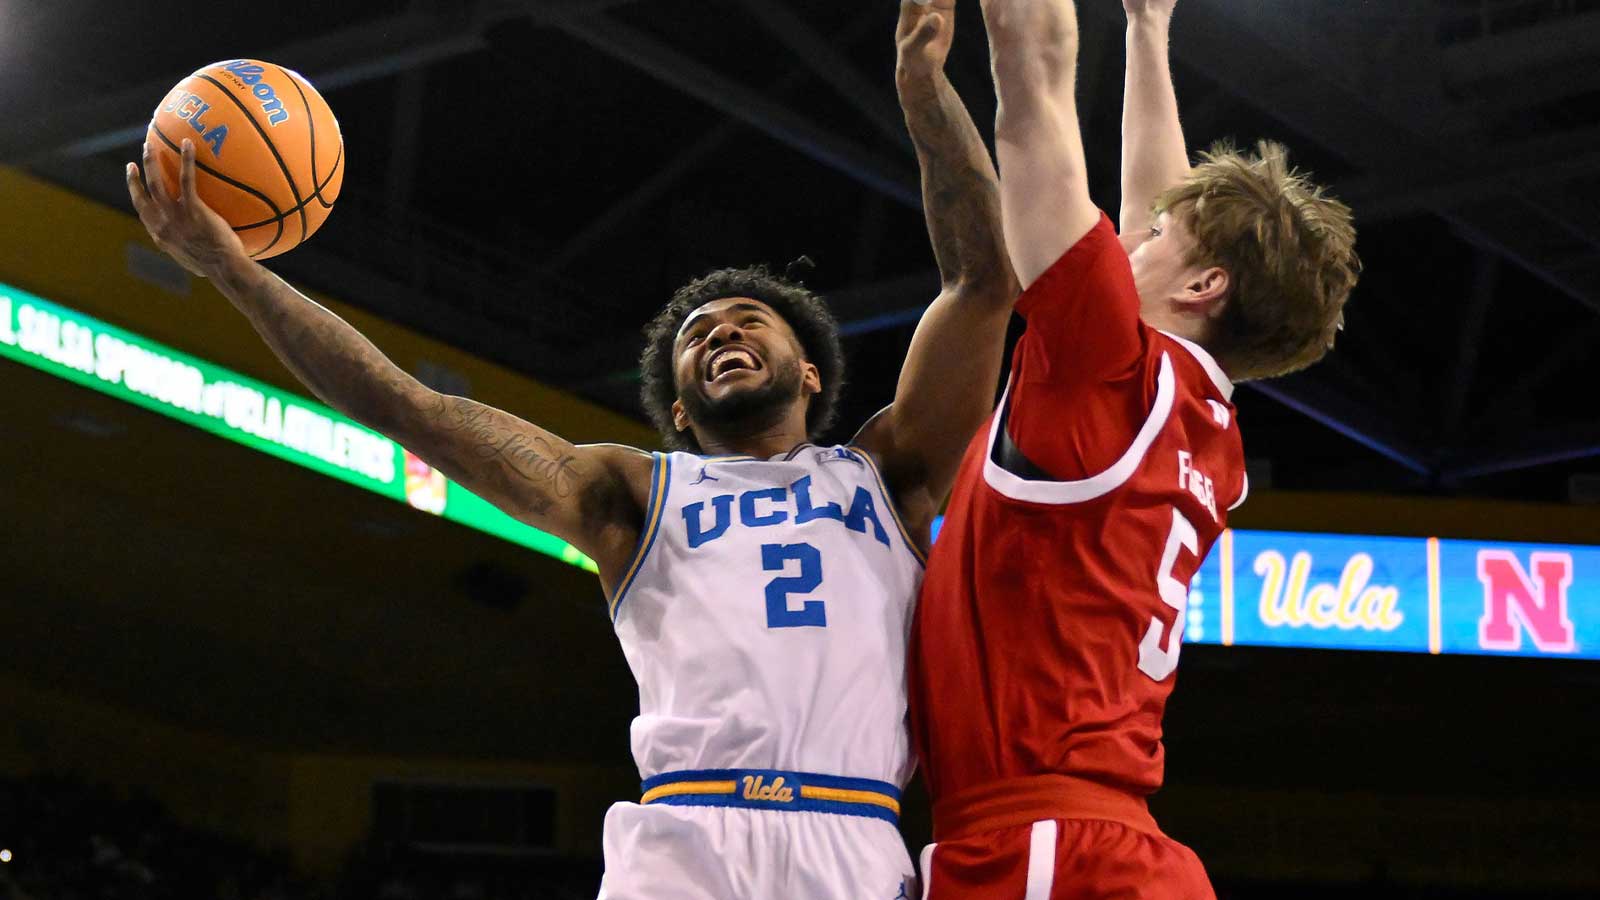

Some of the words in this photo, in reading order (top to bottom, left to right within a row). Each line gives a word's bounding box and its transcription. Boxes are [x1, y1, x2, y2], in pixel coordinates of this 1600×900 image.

[222, 60, 288, 127] ilson
[681, 474, 892, 552] UCLA
[760, 542, 827, 628] 2
[1138, 503, 1199, 682] 5
[1253, 549, 1404, 632] Ucla
[1476, 549, 1575, 652] N
[742, 775, 794, 802] Ucla
